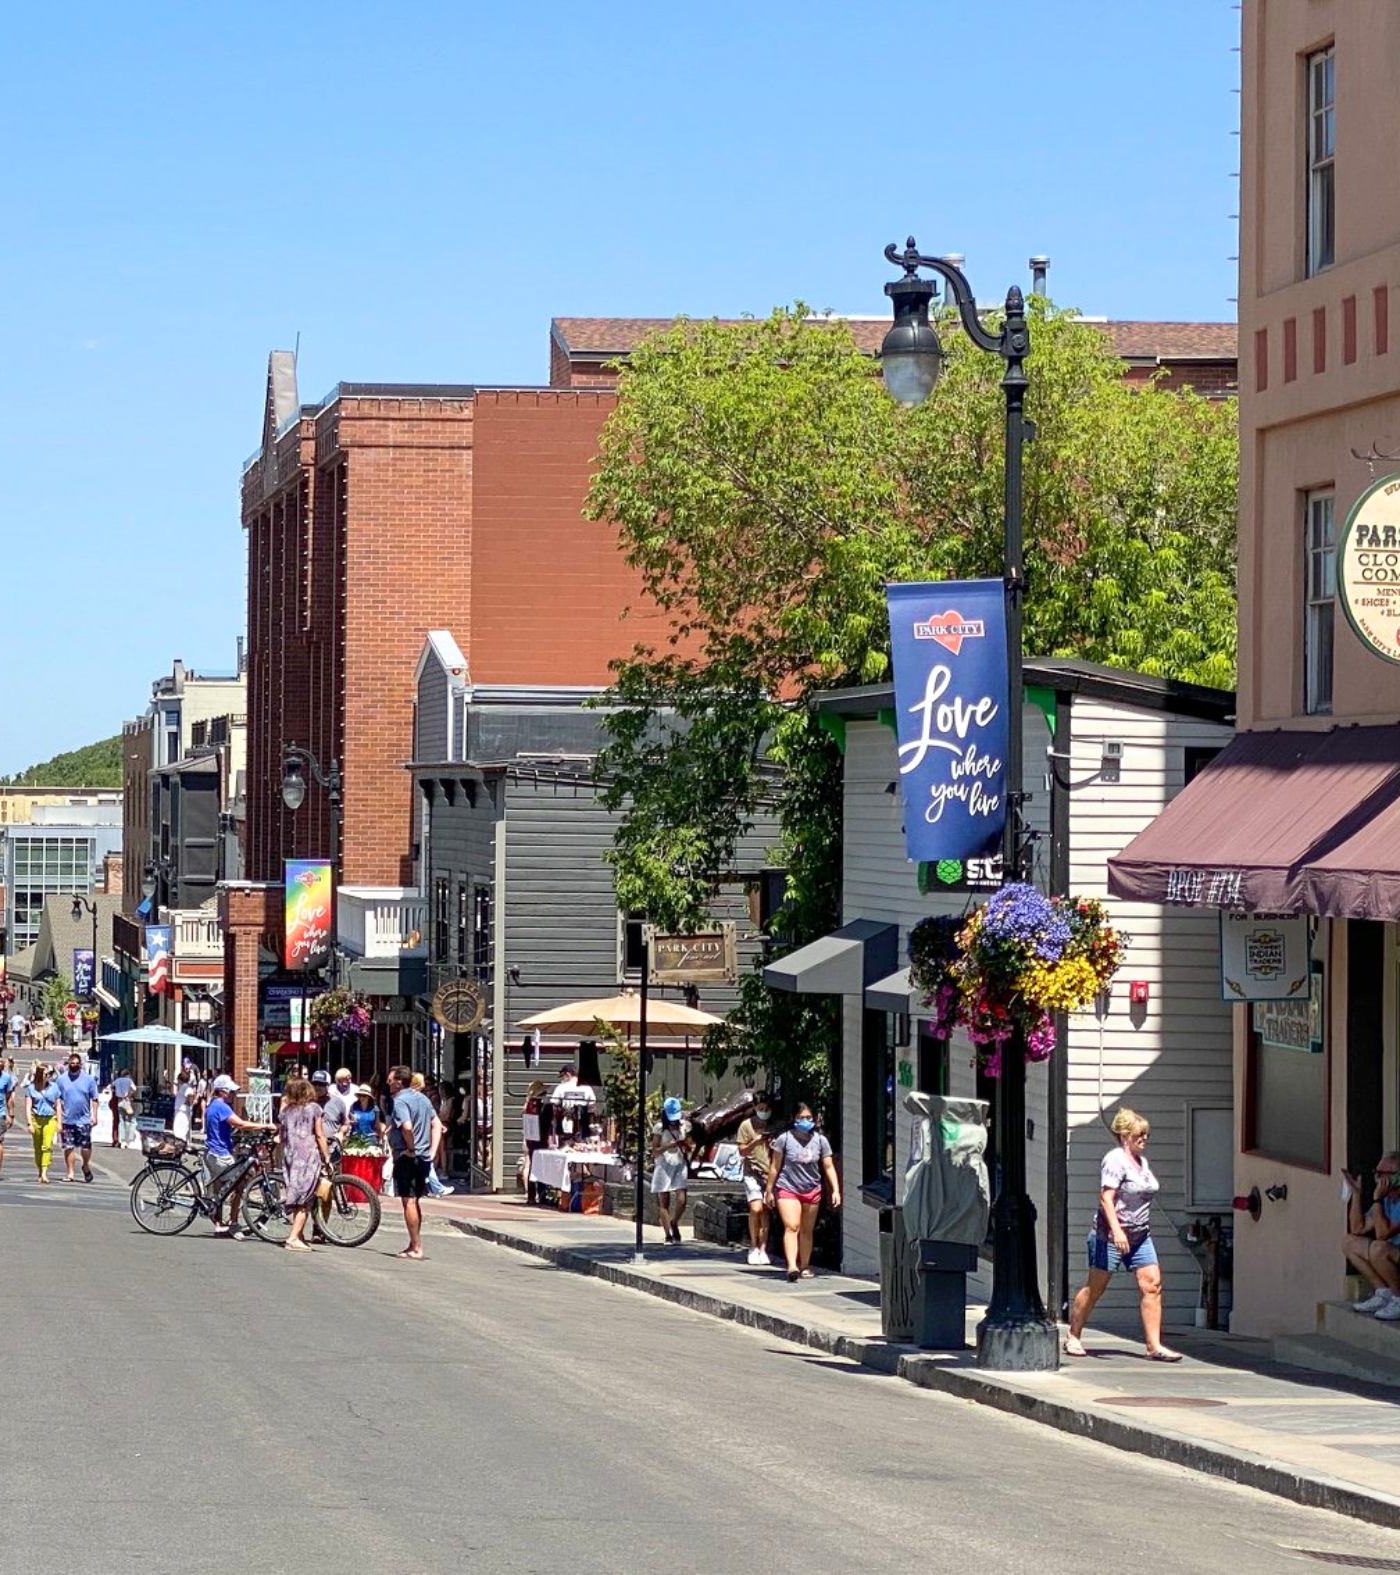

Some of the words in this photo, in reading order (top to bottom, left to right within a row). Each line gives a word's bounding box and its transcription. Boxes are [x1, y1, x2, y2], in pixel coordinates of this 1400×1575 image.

[1356, 524, 1400, 548] PAR
[918, 624, 948, 636] PARK
[950, 623, 979, 635] CITY
[898, 664, 998, 775] Love
[951, 743, 1002, 780] where
[925, 782, 969, 823] you
[968, 781, 1000, 817] live
[285, 892, 327, 936] Love
[1229, 913, 1248, 922] FOR
[657, 943, 688, 953] PARK
[692, 942, 721, 952] CITY
[1249, 950, 1282, 958] INDIAN
